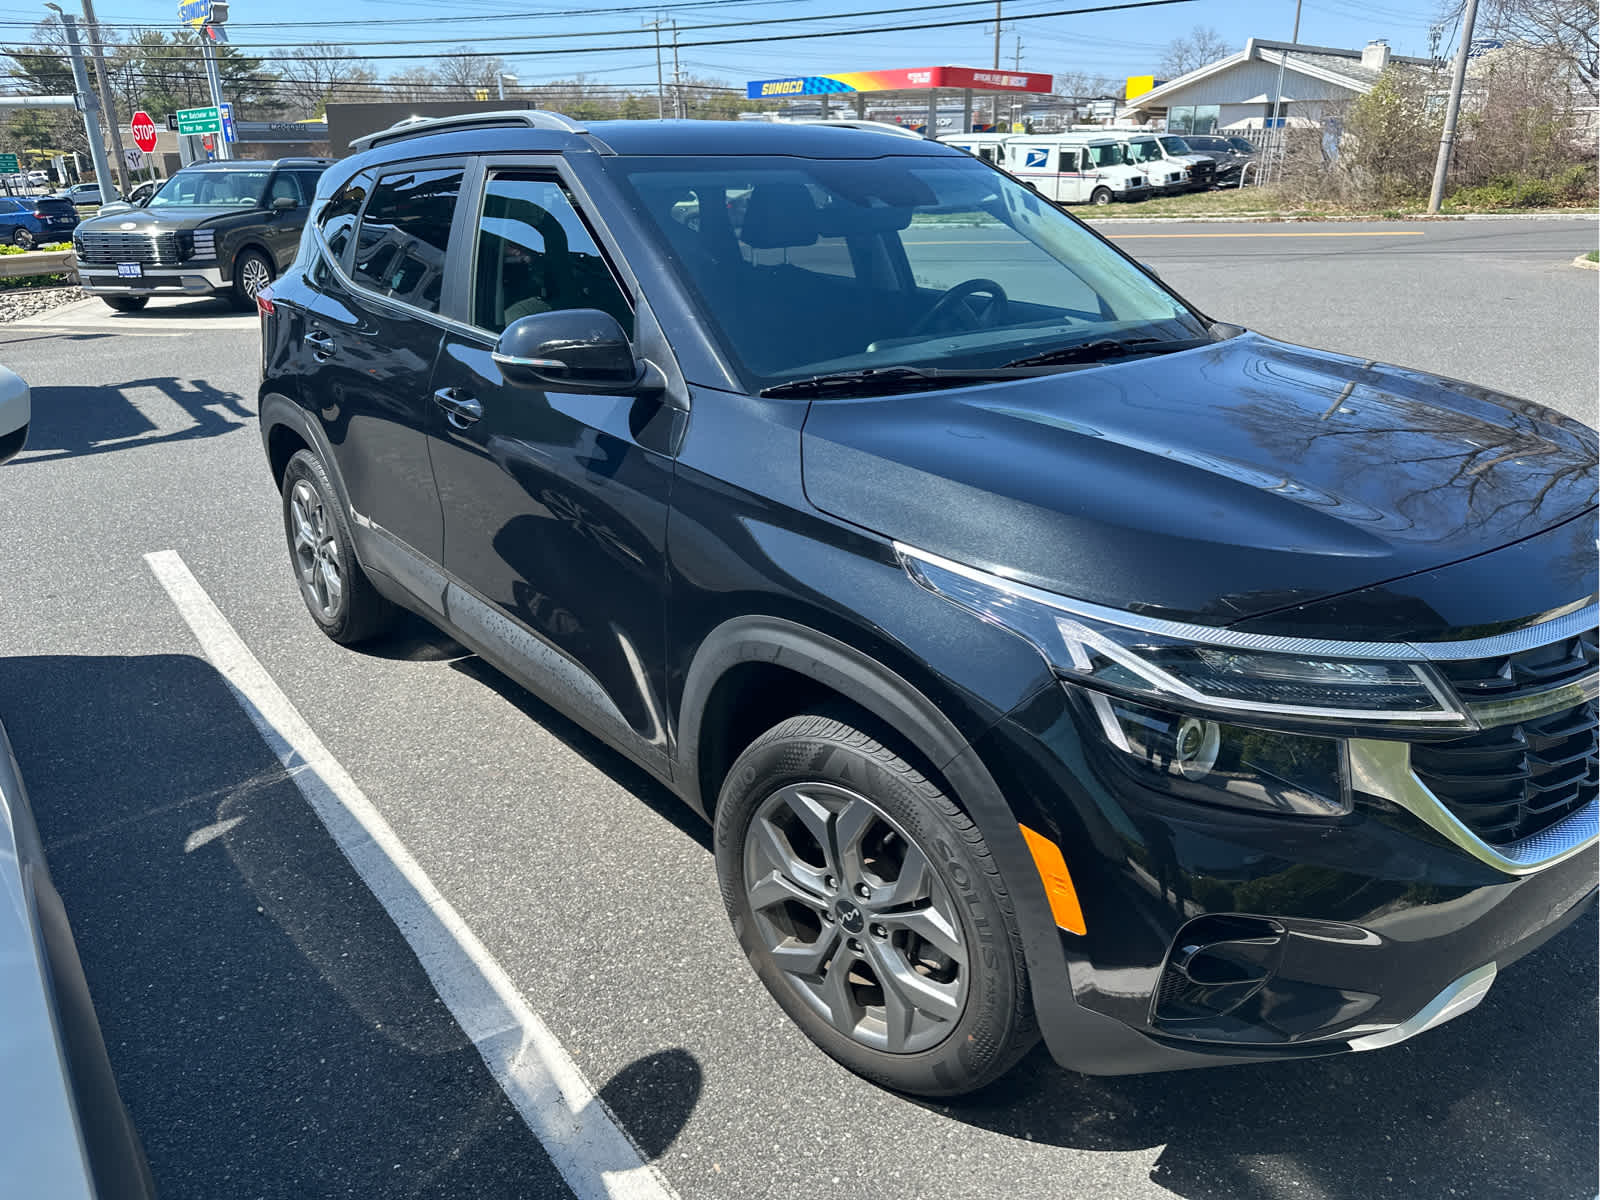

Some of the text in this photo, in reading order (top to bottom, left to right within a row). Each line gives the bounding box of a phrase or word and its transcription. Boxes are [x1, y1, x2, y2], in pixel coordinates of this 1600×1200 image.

[761, 79, 803, 96] SUNOCO
[133, 124, 154, 141] STOP
[932, 838, 1000, 971] SOLUS
